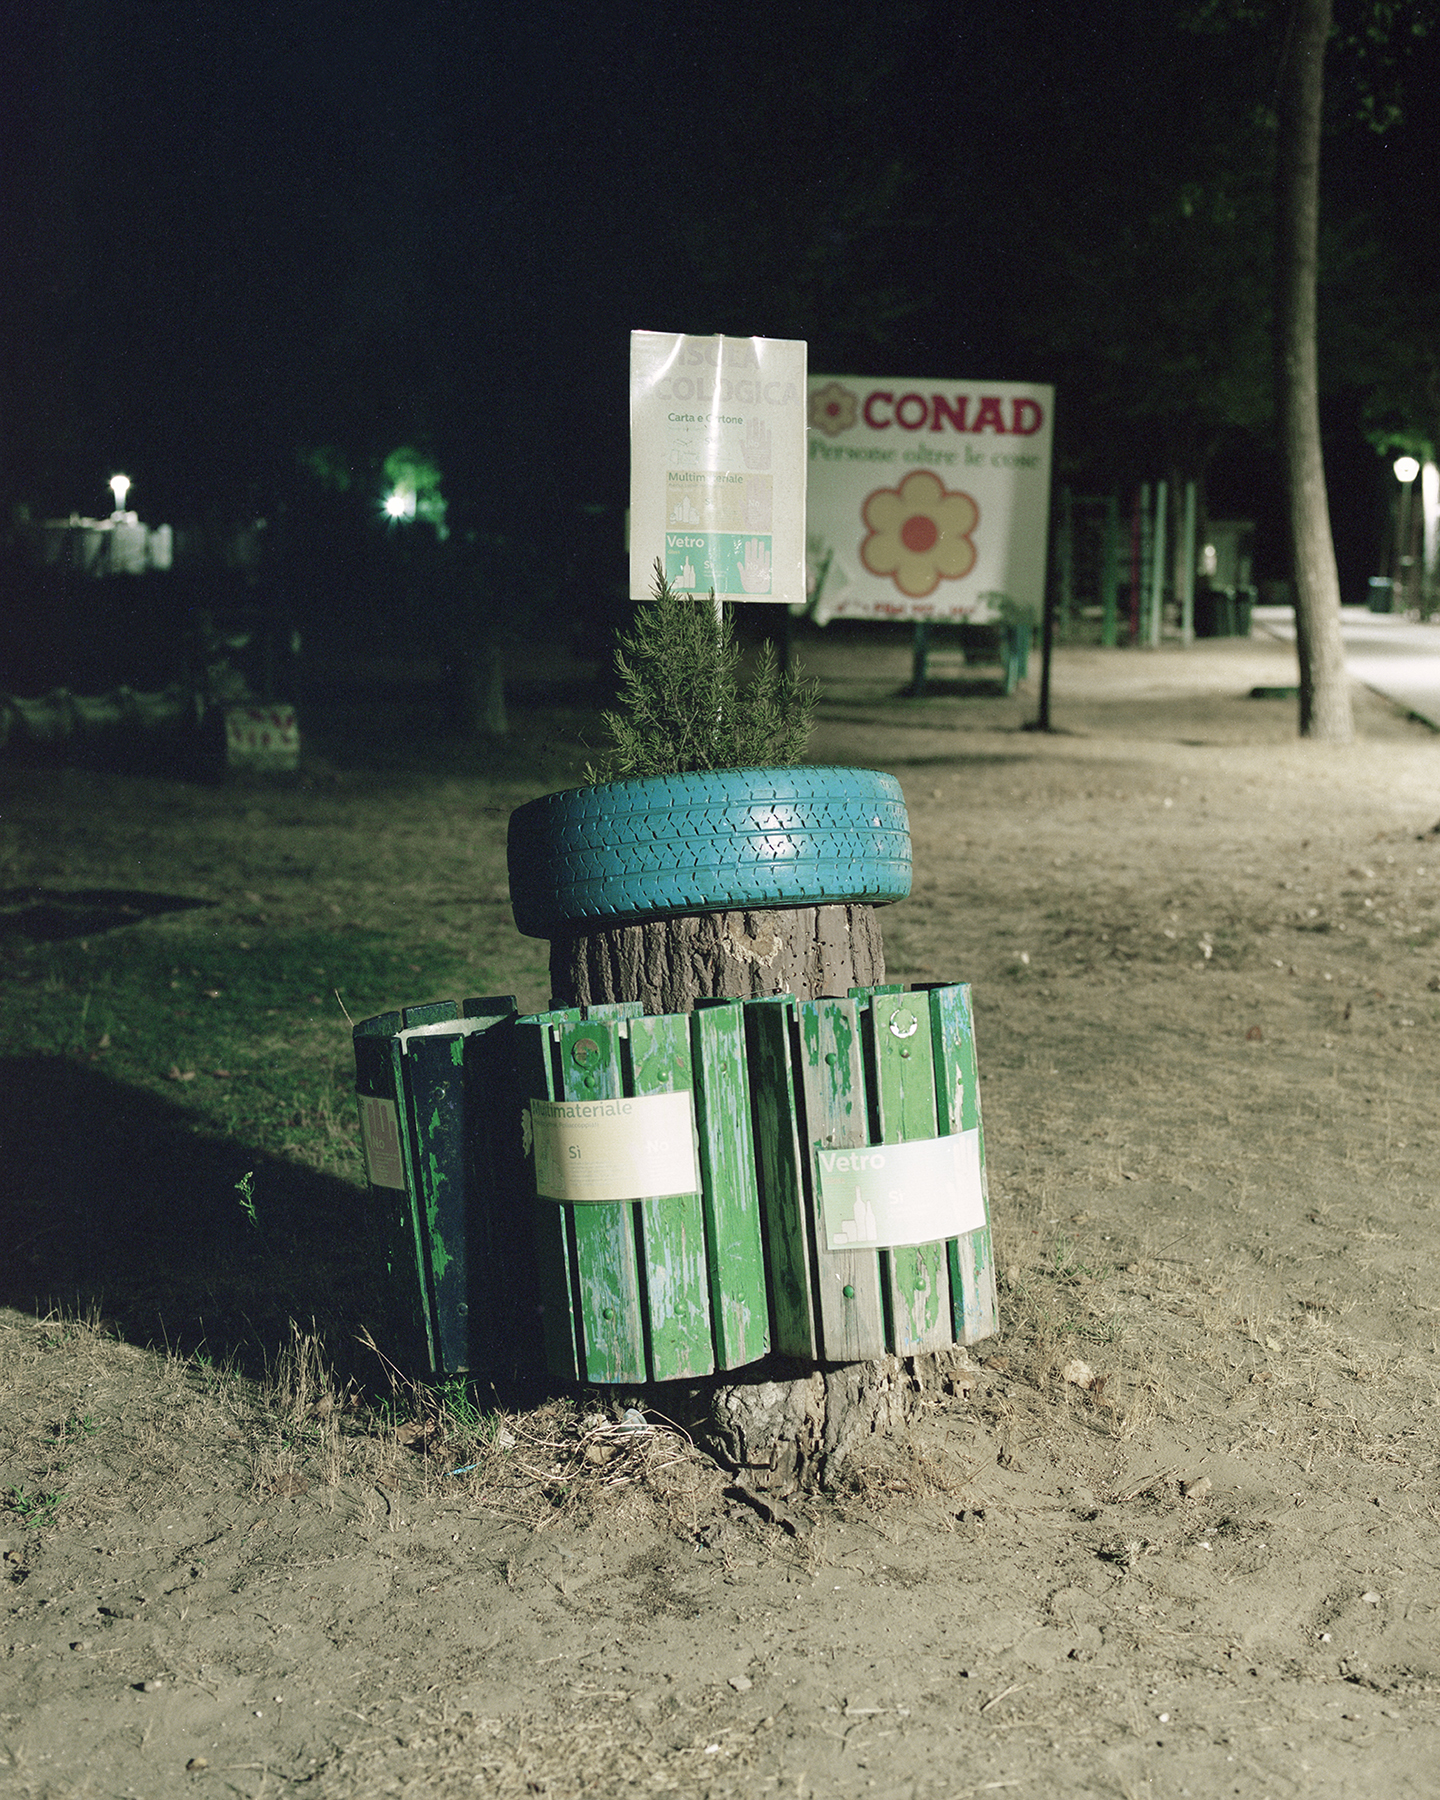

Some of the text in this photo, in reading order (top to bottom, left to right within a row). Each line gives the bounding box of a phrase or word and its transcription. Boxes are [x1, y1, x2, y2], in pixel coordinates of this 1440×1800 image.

[642, 374, 799, 406] COLOGICA
[668, 412, 744, 425] Carta e Crtone
[863, 391, 1043, 436] CONAD
[668, 472, 744, 484] Multimeriale
[667, 535, 705, 548] Vetro
[568, 1145, 582, 1159] Sì
[646, 1139, 670, 1154] No
[820, 1152, 886, 1173] Vetro
